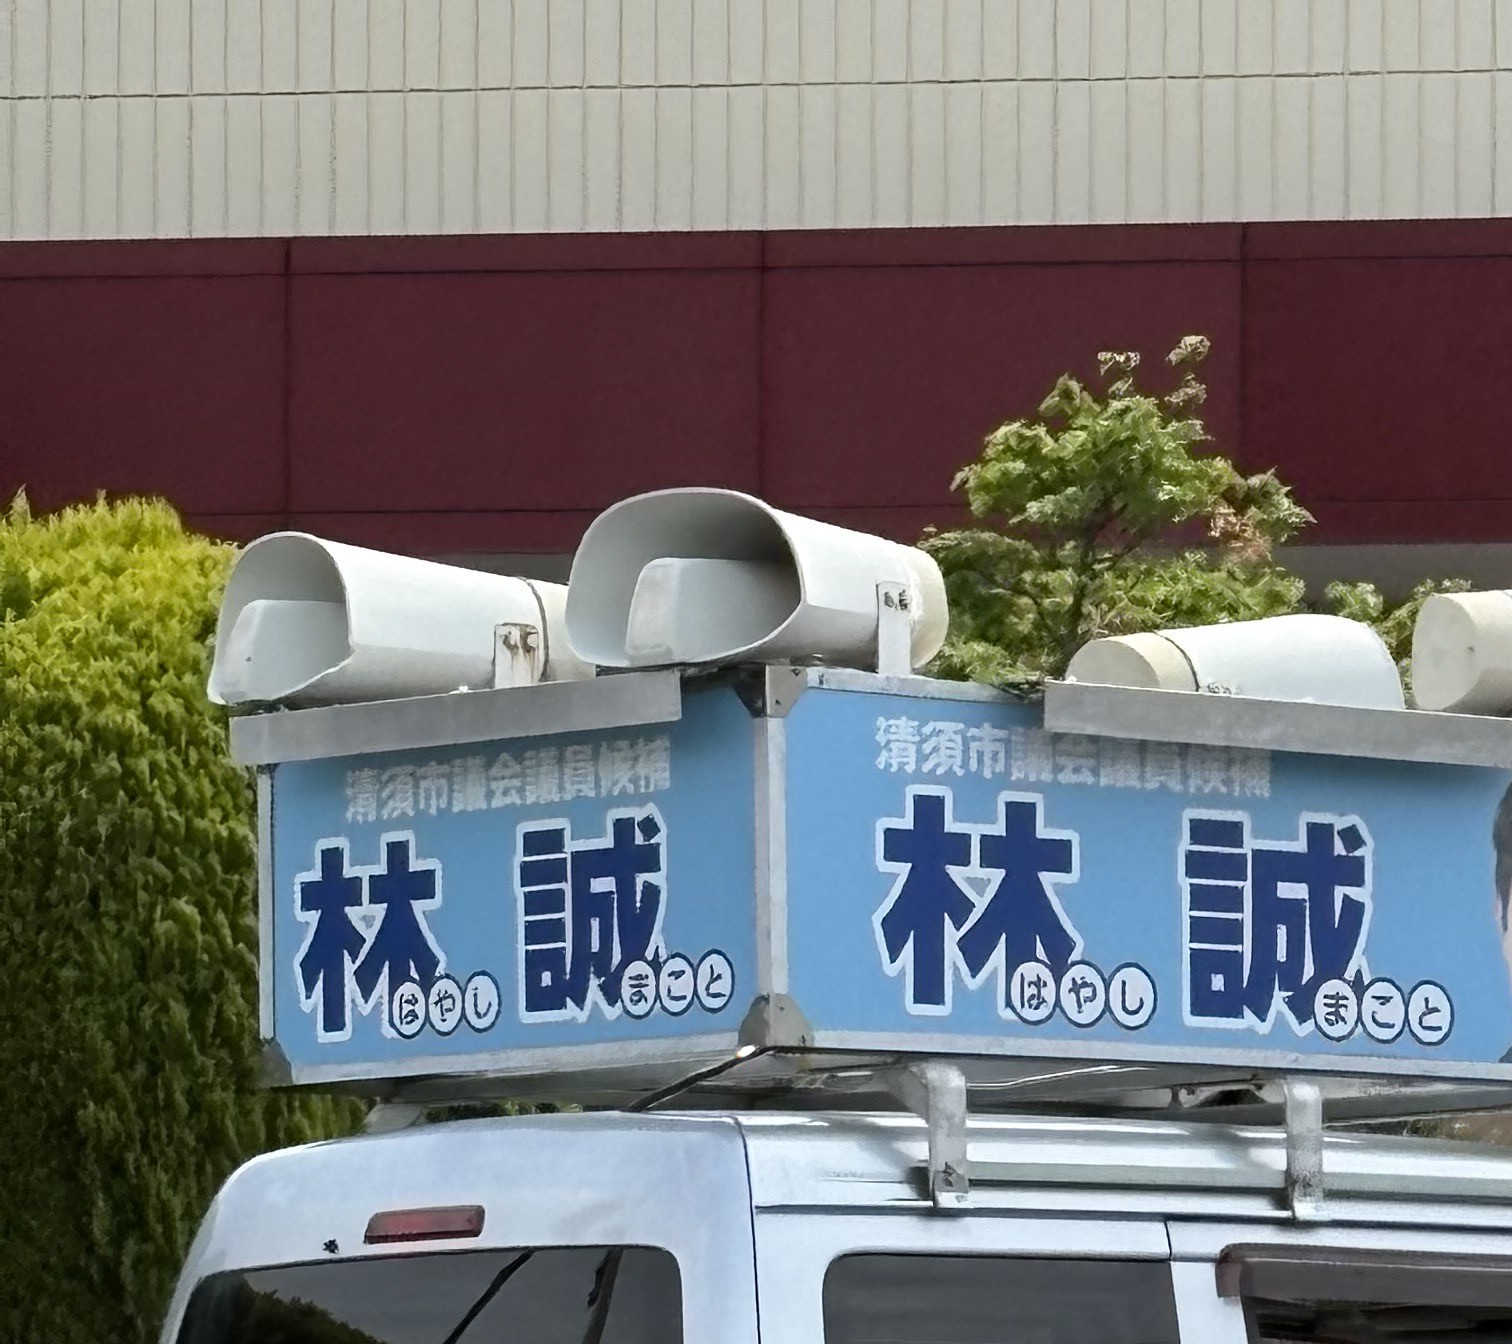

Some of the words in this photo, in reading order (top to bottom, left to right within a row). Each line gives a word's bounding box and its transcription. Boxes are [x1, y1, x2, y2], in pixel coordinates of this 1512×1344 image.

[297, 834, 443, 1039] 林
[519, 808, 665, 1018] 誠
[879, 791, 1079, 1012] 林
[1185, 814, 1371, 1029] 誠
[389, 969, 501, 1040] はやし
[620, 948, 735, 1019] まこと
[1009, 960, 1158, 1030] はやし
[1313, 976, 1454, 1047] まこと
